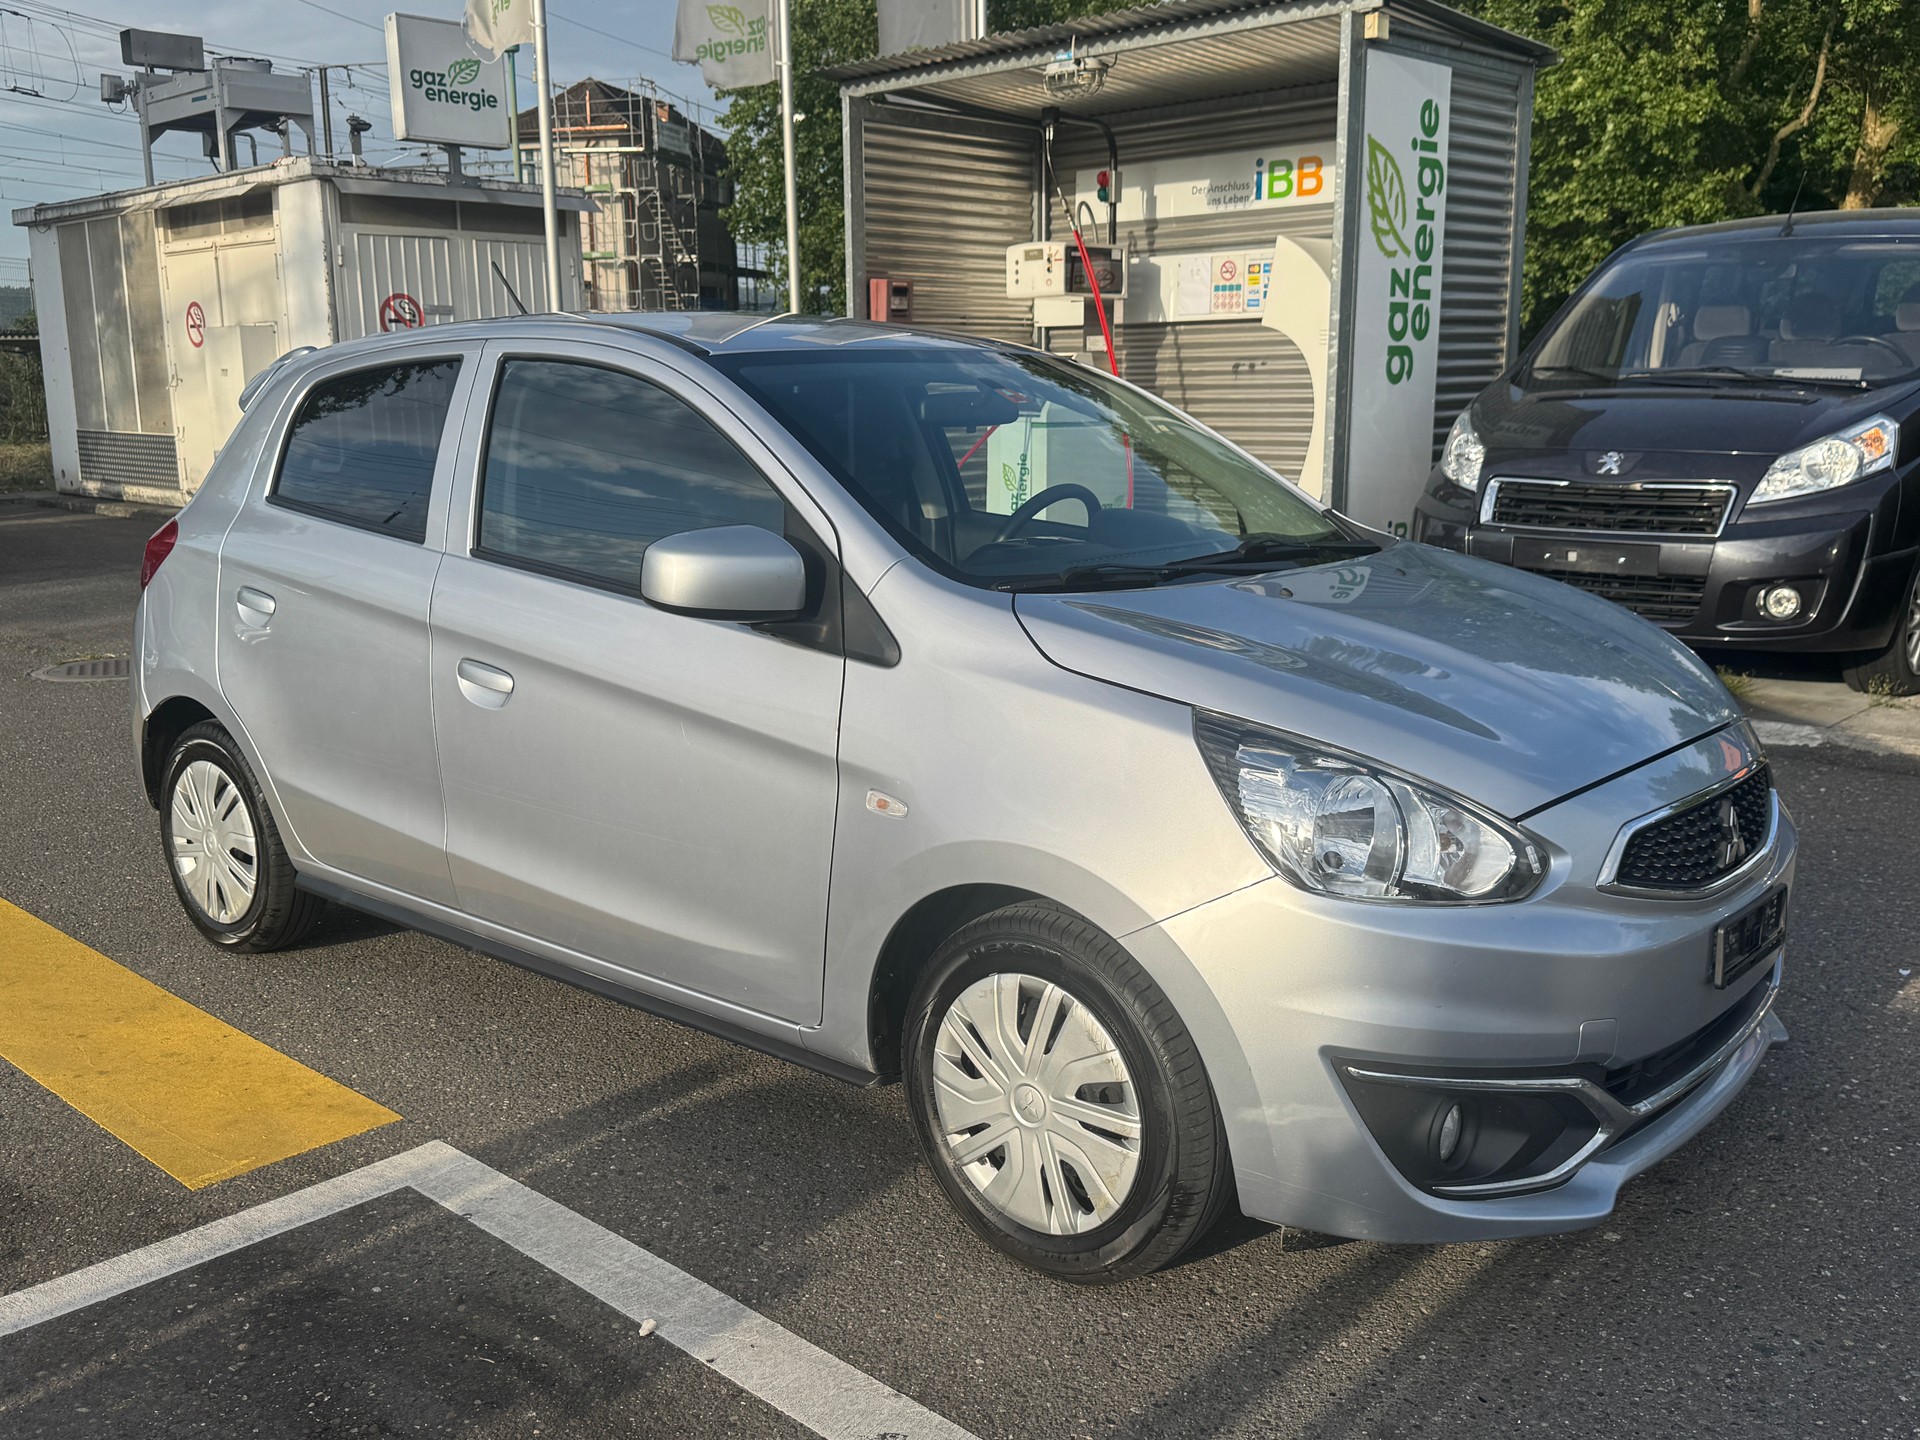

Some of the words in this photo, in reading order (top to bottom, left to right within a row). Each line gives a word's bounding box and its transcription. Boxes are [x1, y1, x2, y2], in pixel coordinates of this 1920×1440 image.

[410, 69, 447, 89] gaz
[424, 87, 498, 111] energie
[1191, 185, 1207, 196] Der
[1207, 181, 1250, 194] Anschluss
[1223, 194, 1250, 205] Leben
[1410, 98, 1444, 341] energie
[1385, 267, 1414, 385] gaz
[1017, 452, 1030, 506] nergie
[1010, 492, 1019, 513] az
